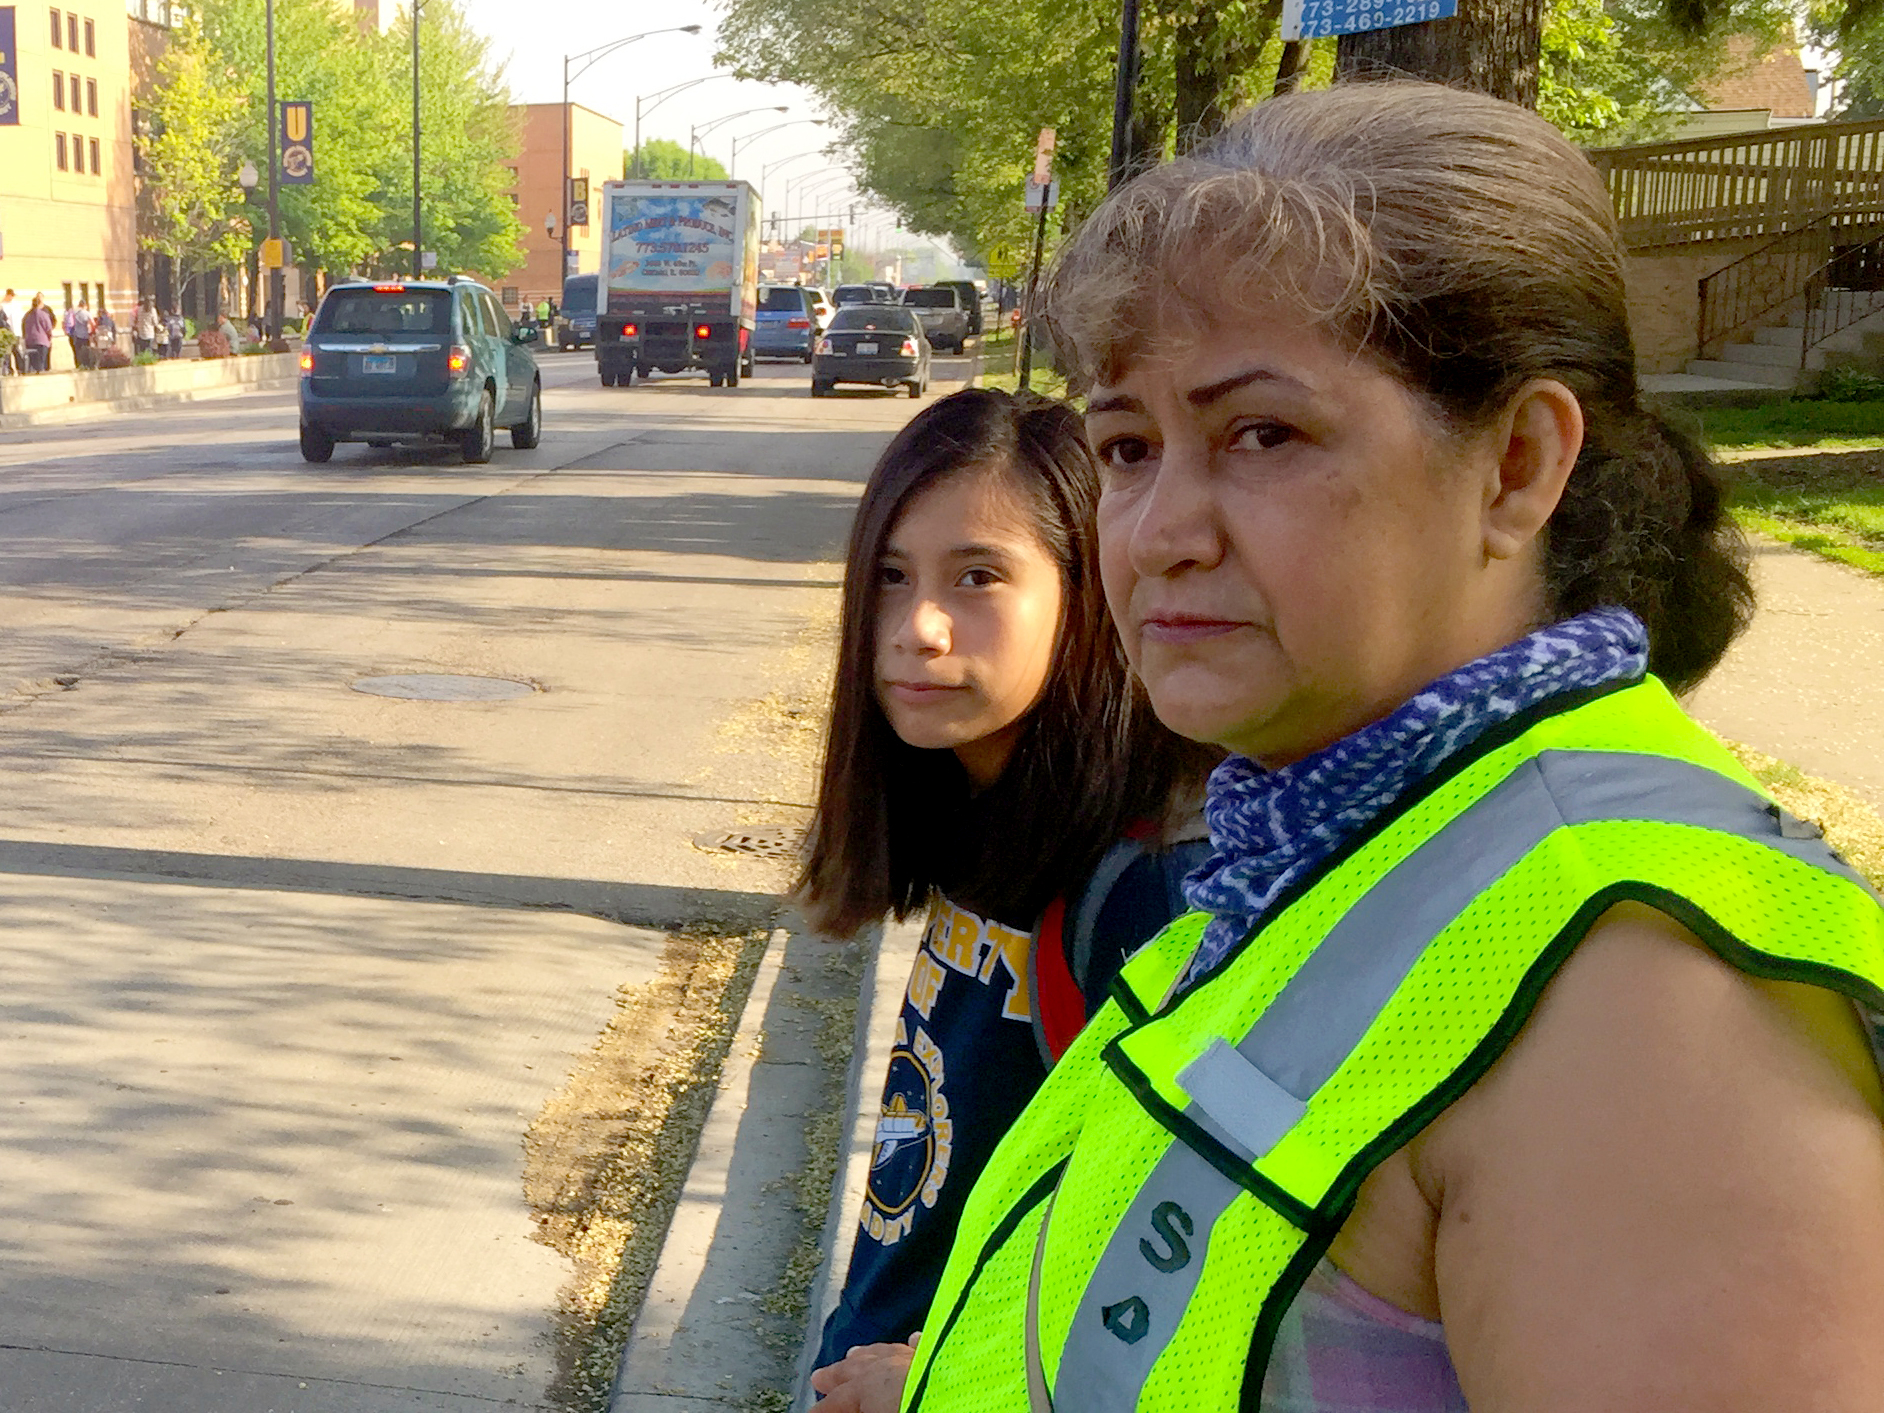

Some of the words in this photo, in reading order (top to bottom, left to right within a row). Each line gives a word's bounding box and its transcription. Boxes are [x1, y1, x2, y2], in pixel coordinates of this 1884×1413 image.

[286, 106, 307, 142] U
[907, 949, 947, 1022] OF
[912, 1025, 953, 1209] EXPLORERS
